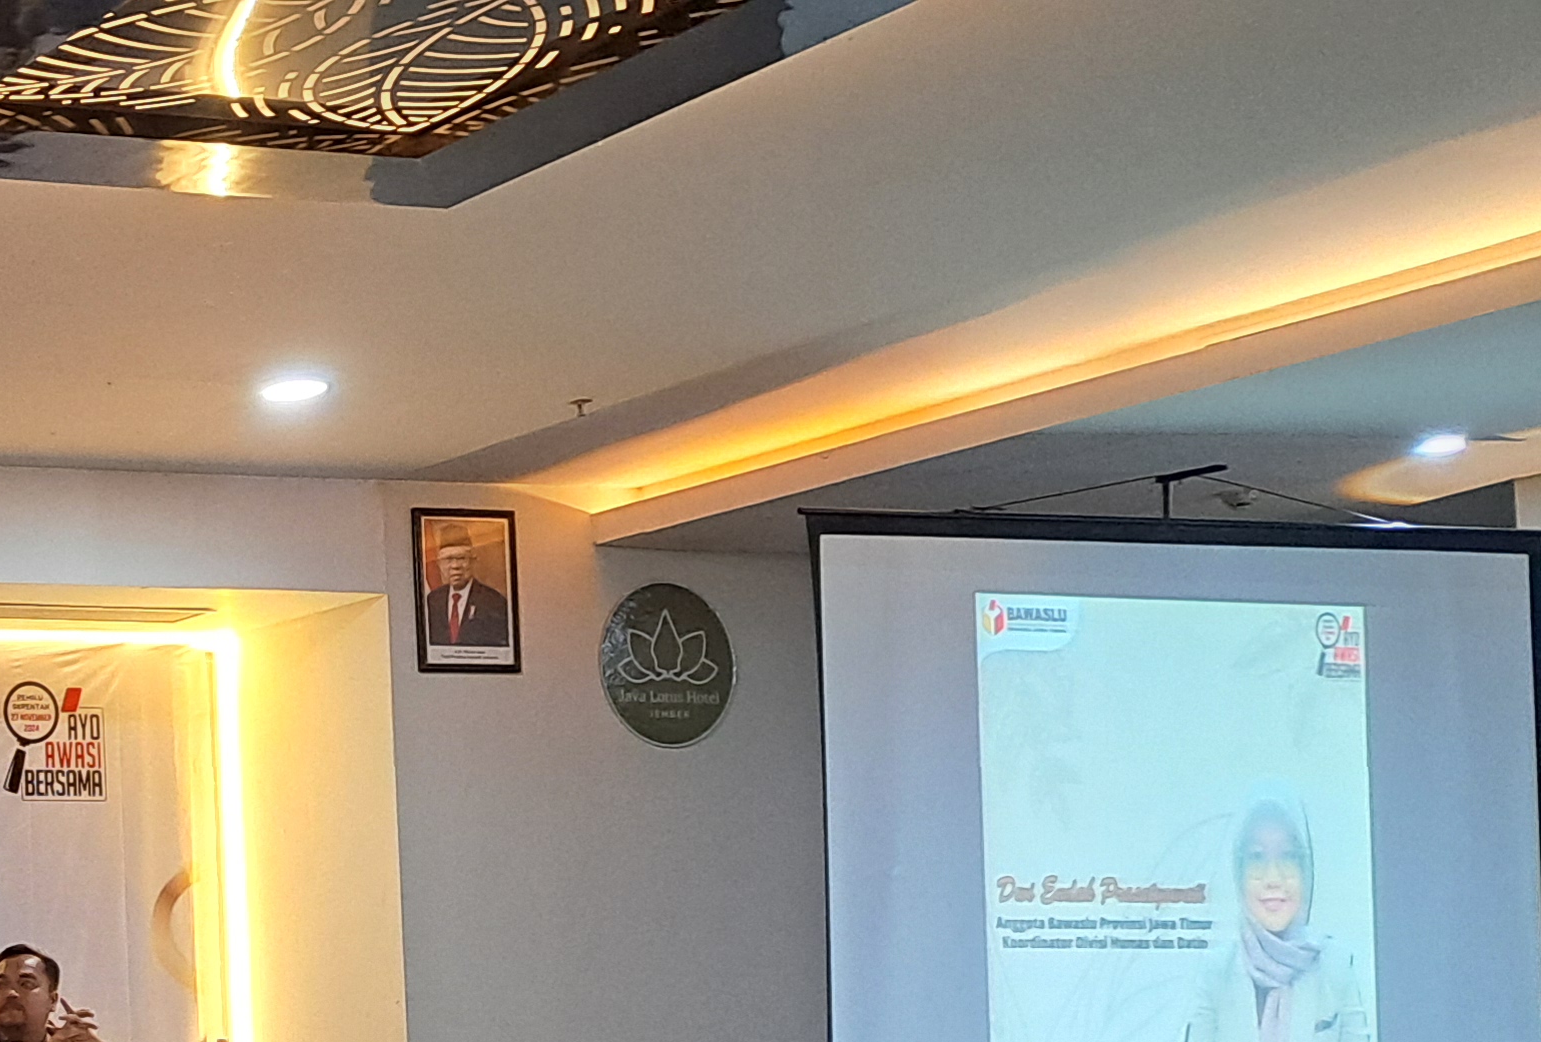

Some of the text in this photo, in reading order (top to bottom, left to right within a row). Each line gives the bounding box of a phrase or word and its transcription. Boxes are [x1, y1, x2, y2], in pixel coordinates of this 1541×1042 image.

[617, 689, 647, 703] Java
[686, 690, 720, 705] Hotel
[67, 714, 101, 741] AYO
[45, 741, 102, 769] AWASI
[25, 769, 103, 797] BERSAMA
